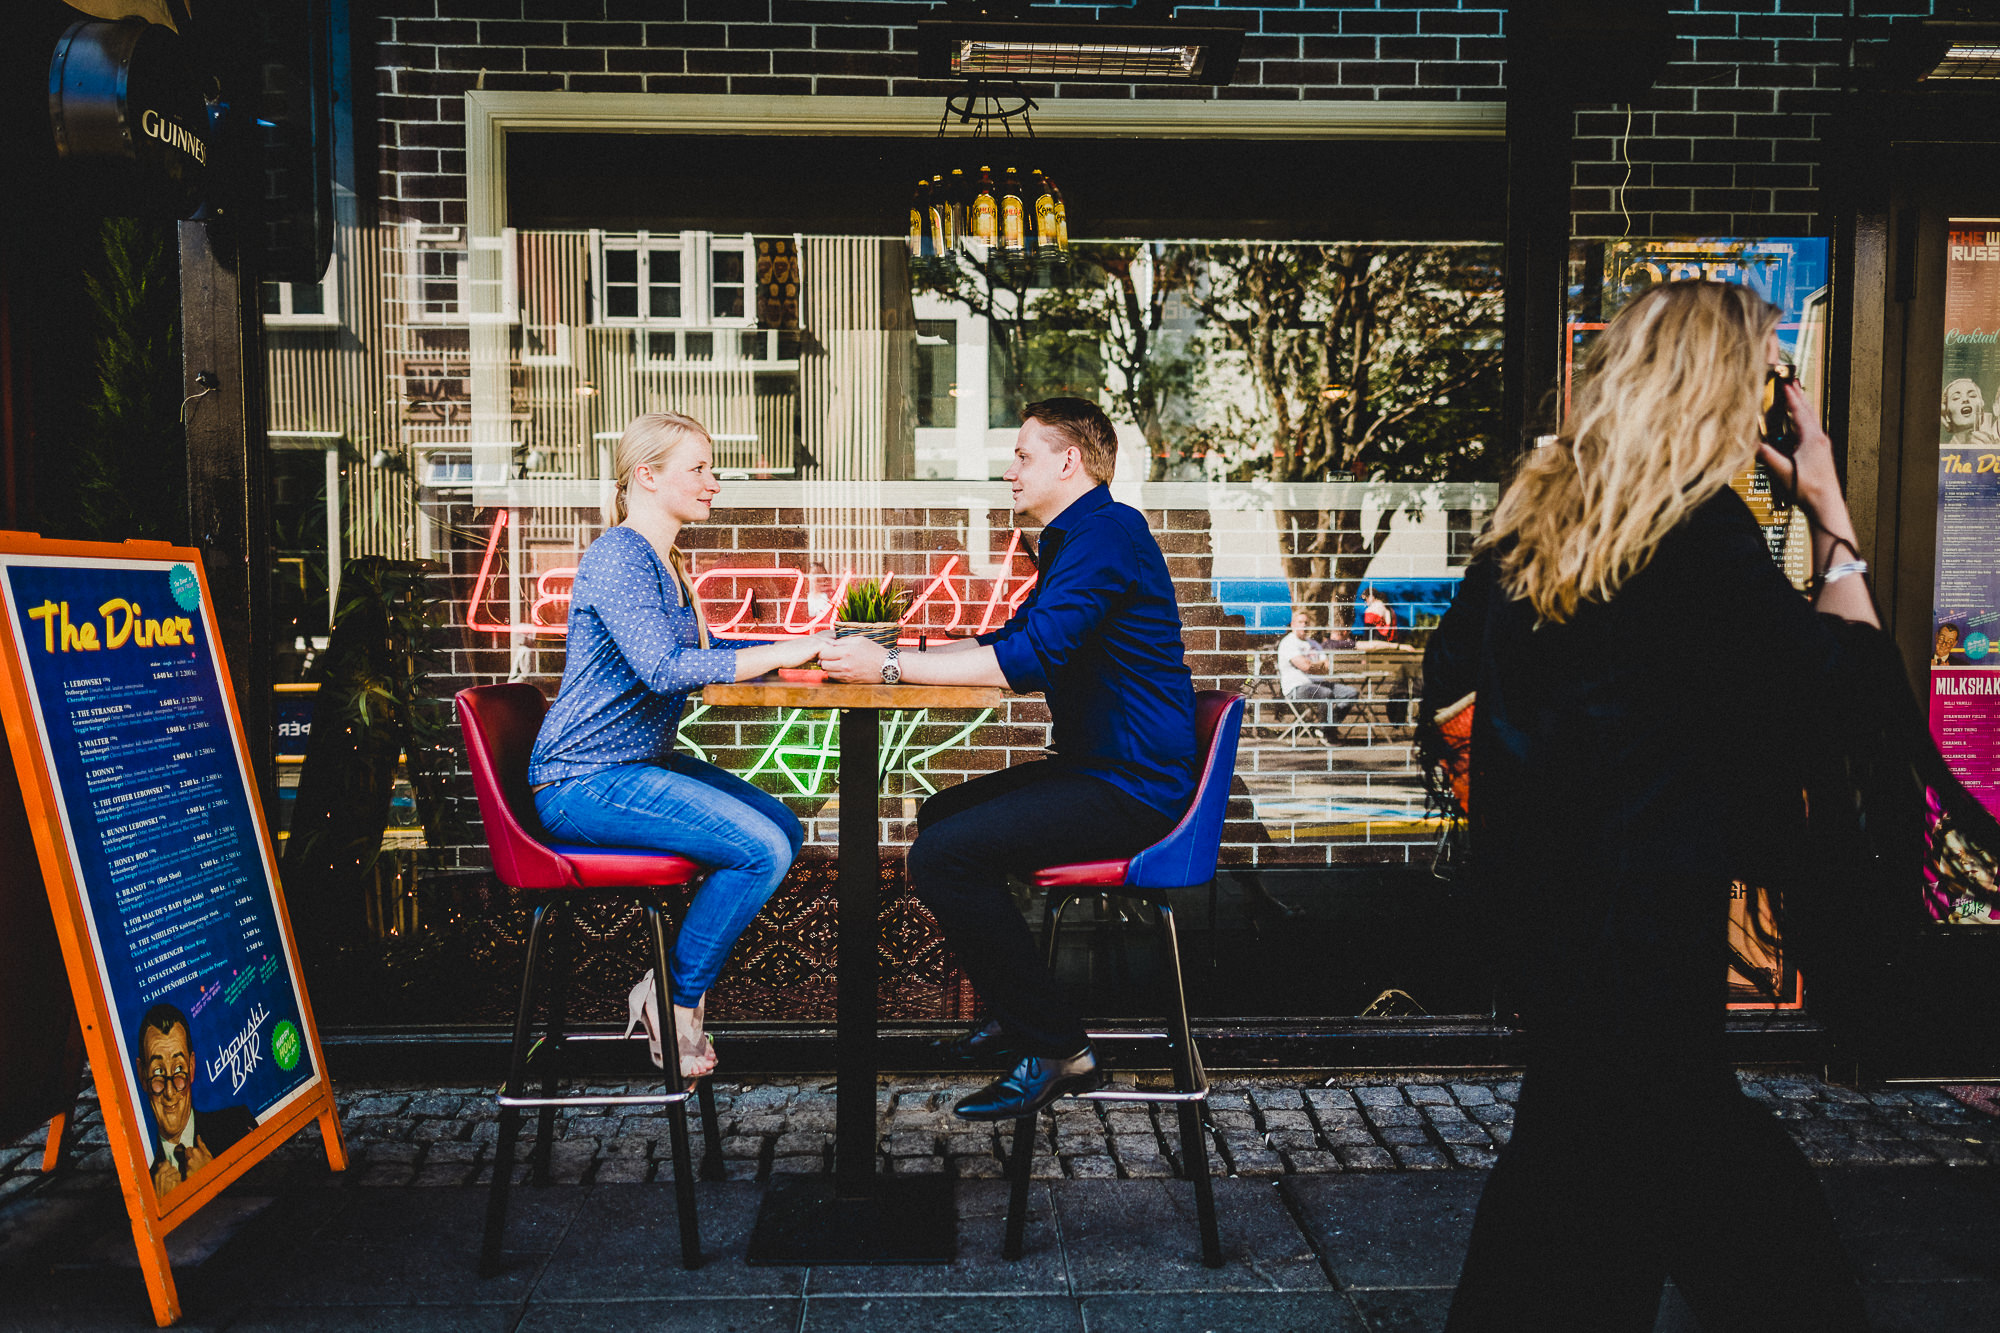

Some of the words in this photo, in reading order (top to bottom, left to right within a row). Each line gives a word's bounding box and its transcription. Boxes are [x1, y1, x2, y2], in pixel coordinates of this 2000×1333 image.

[142, 109, 206, 167] GUINNES
[1949, 231, 1985, 246] THE
[1951, 246, 2000, 261] RUSS
[1941, 454, 1973, 474] The
[28, 598, 101, 653] The
[98, 597, 196, 651] Diner
[69, 678, 102, 687] LEBOWSKI
[1935, 677, 2000, 696] MILKSHAK
[76, 709, 90, 717] THE
[90, 705, 123, 716] STRANGER
[83, 737, 109, 747] WALTER
[91, 766, 114, 777] DONNY
[99, 798, 112, 807] THE
[112, 793, 133, 804] OTHER
[132, 785, 163, 799] LEBOWSKI
[106, 824, 128, 836] BUNNY
[128, 816, 158, 830] LEBOWSKI
[113, 855, 134, 867] HONEY
[135, 850, 148, 860] BOO
[121, 882, 146, 896] BRANDT
[129, 915, 141, 926] FOR
[167, 900, 182, 911] BABY
[138, 936, 150, 946] THE
[150, 924, 178, 941] NIHILISTS
[146, 960, 187, 984] OSTASTANGIR
[231, 1031, 264, 1097] BAR
